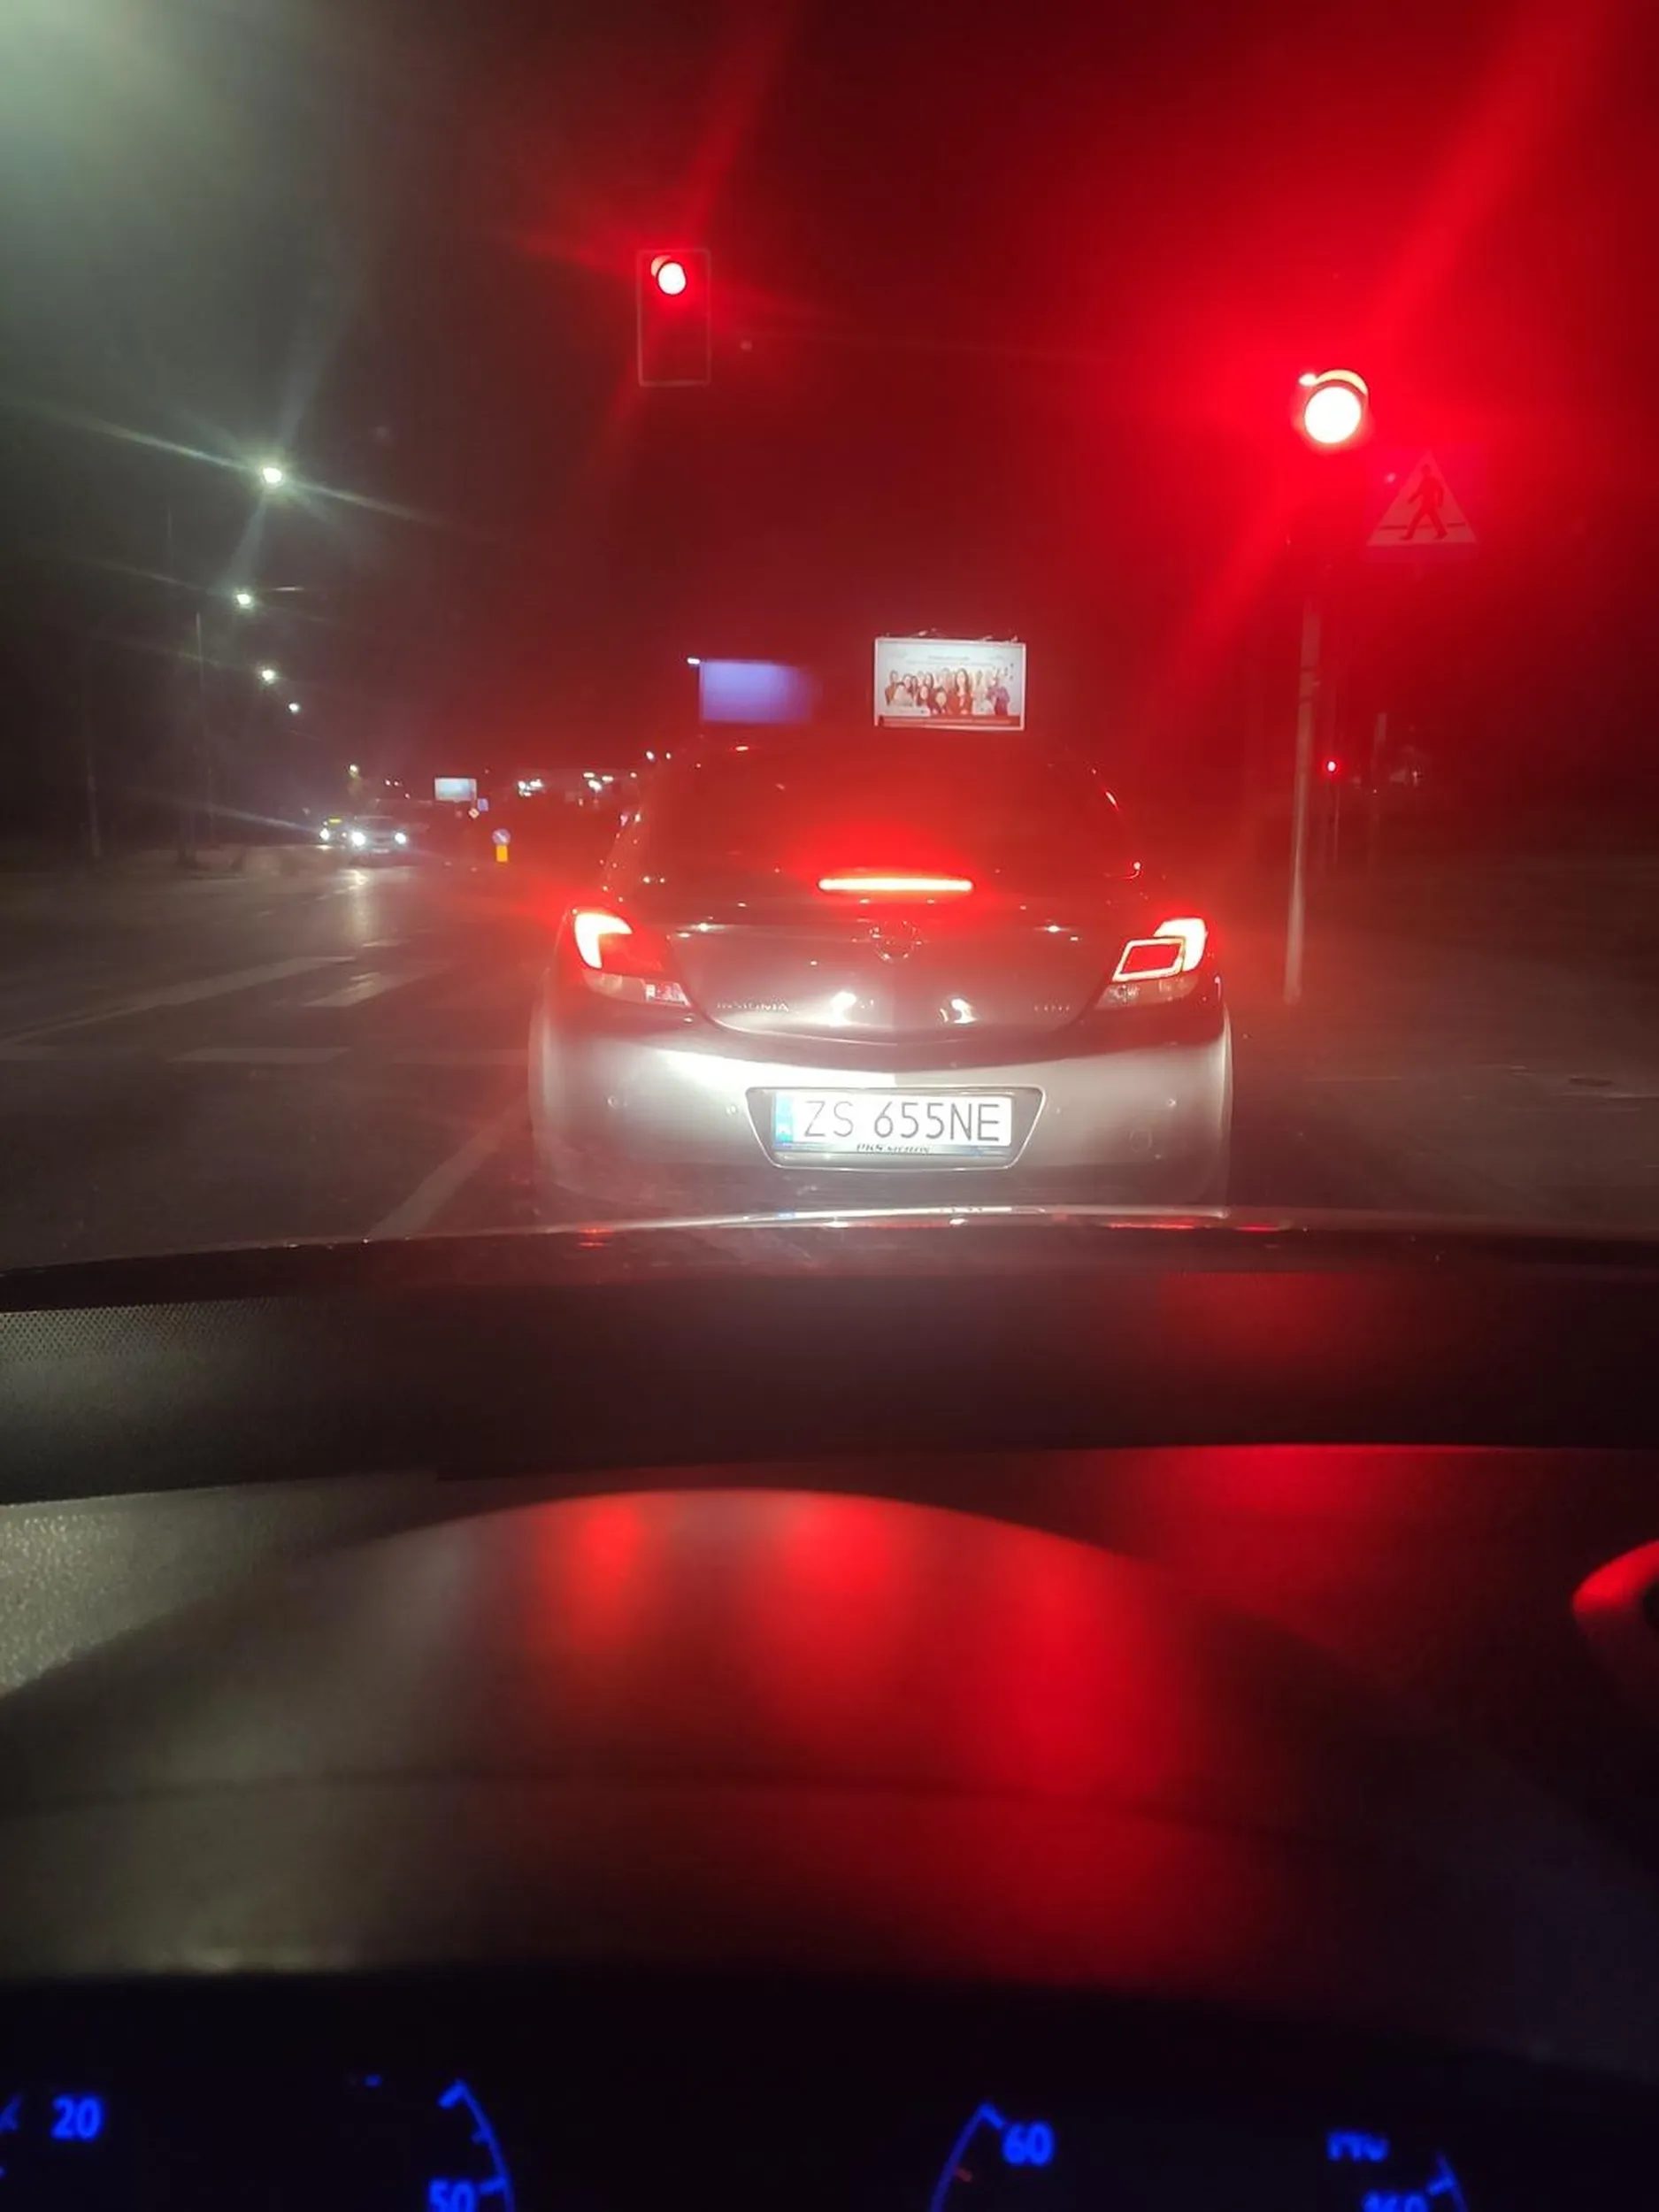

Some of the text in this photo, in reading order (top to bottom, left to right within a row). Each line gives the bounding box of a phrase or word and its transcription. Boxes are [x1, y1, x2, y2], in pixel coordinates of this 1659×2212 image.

[803, 1100, 1000, 1142] ZS 655NE
[51, 2093, 102, 2139] 20
[1002, 2122, 1054, 2166] 60
[428, 2177, 476, 2212] 50
